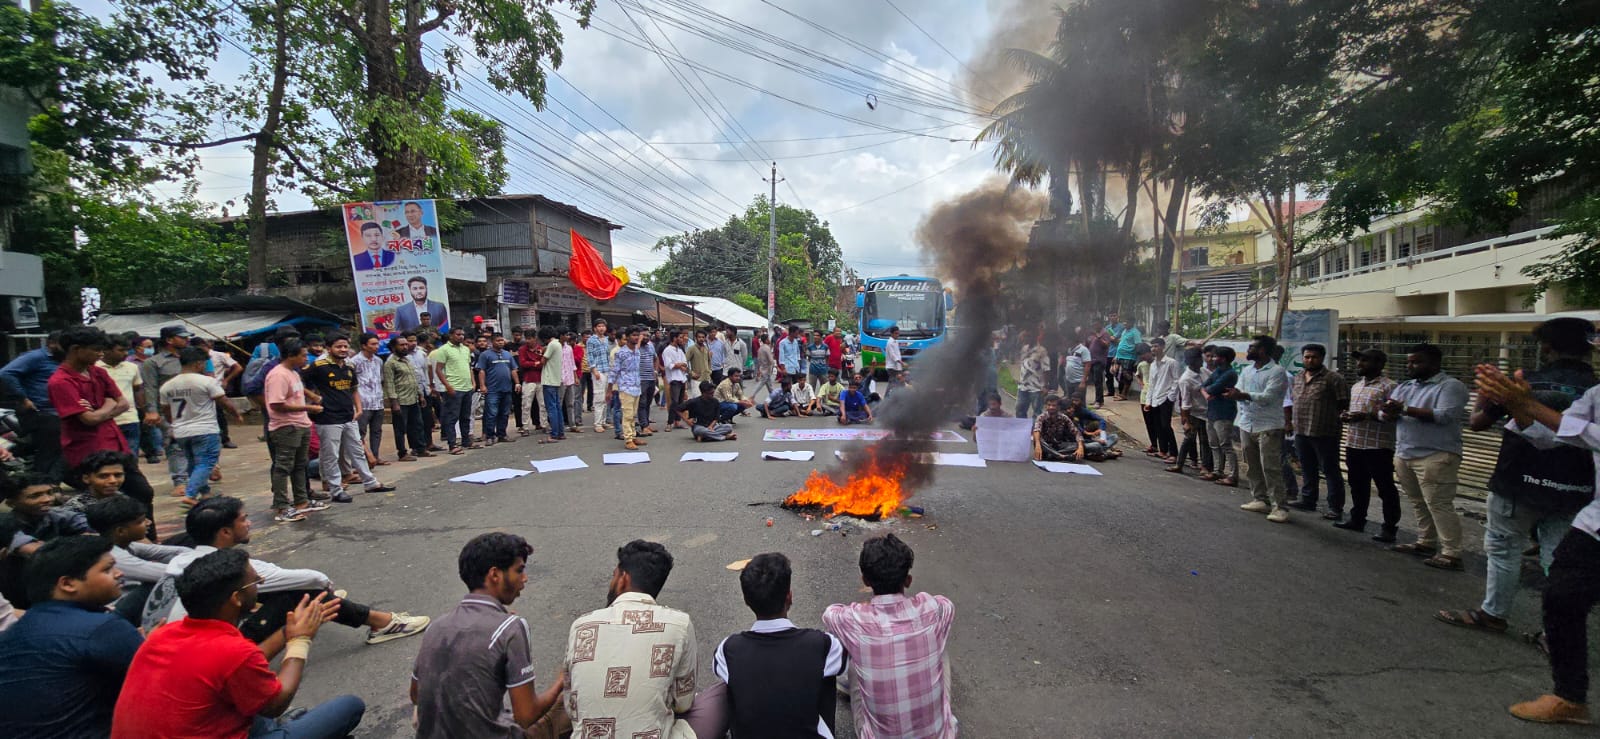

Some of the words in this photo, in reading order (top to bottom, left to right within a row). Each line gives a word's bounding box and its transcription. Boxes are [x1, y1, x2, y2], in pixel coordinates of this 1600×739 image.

[869, 281, 930, 292] Paharik
[172, 398, 187, 418] 7
[1521, 474, 1541, 485] The
